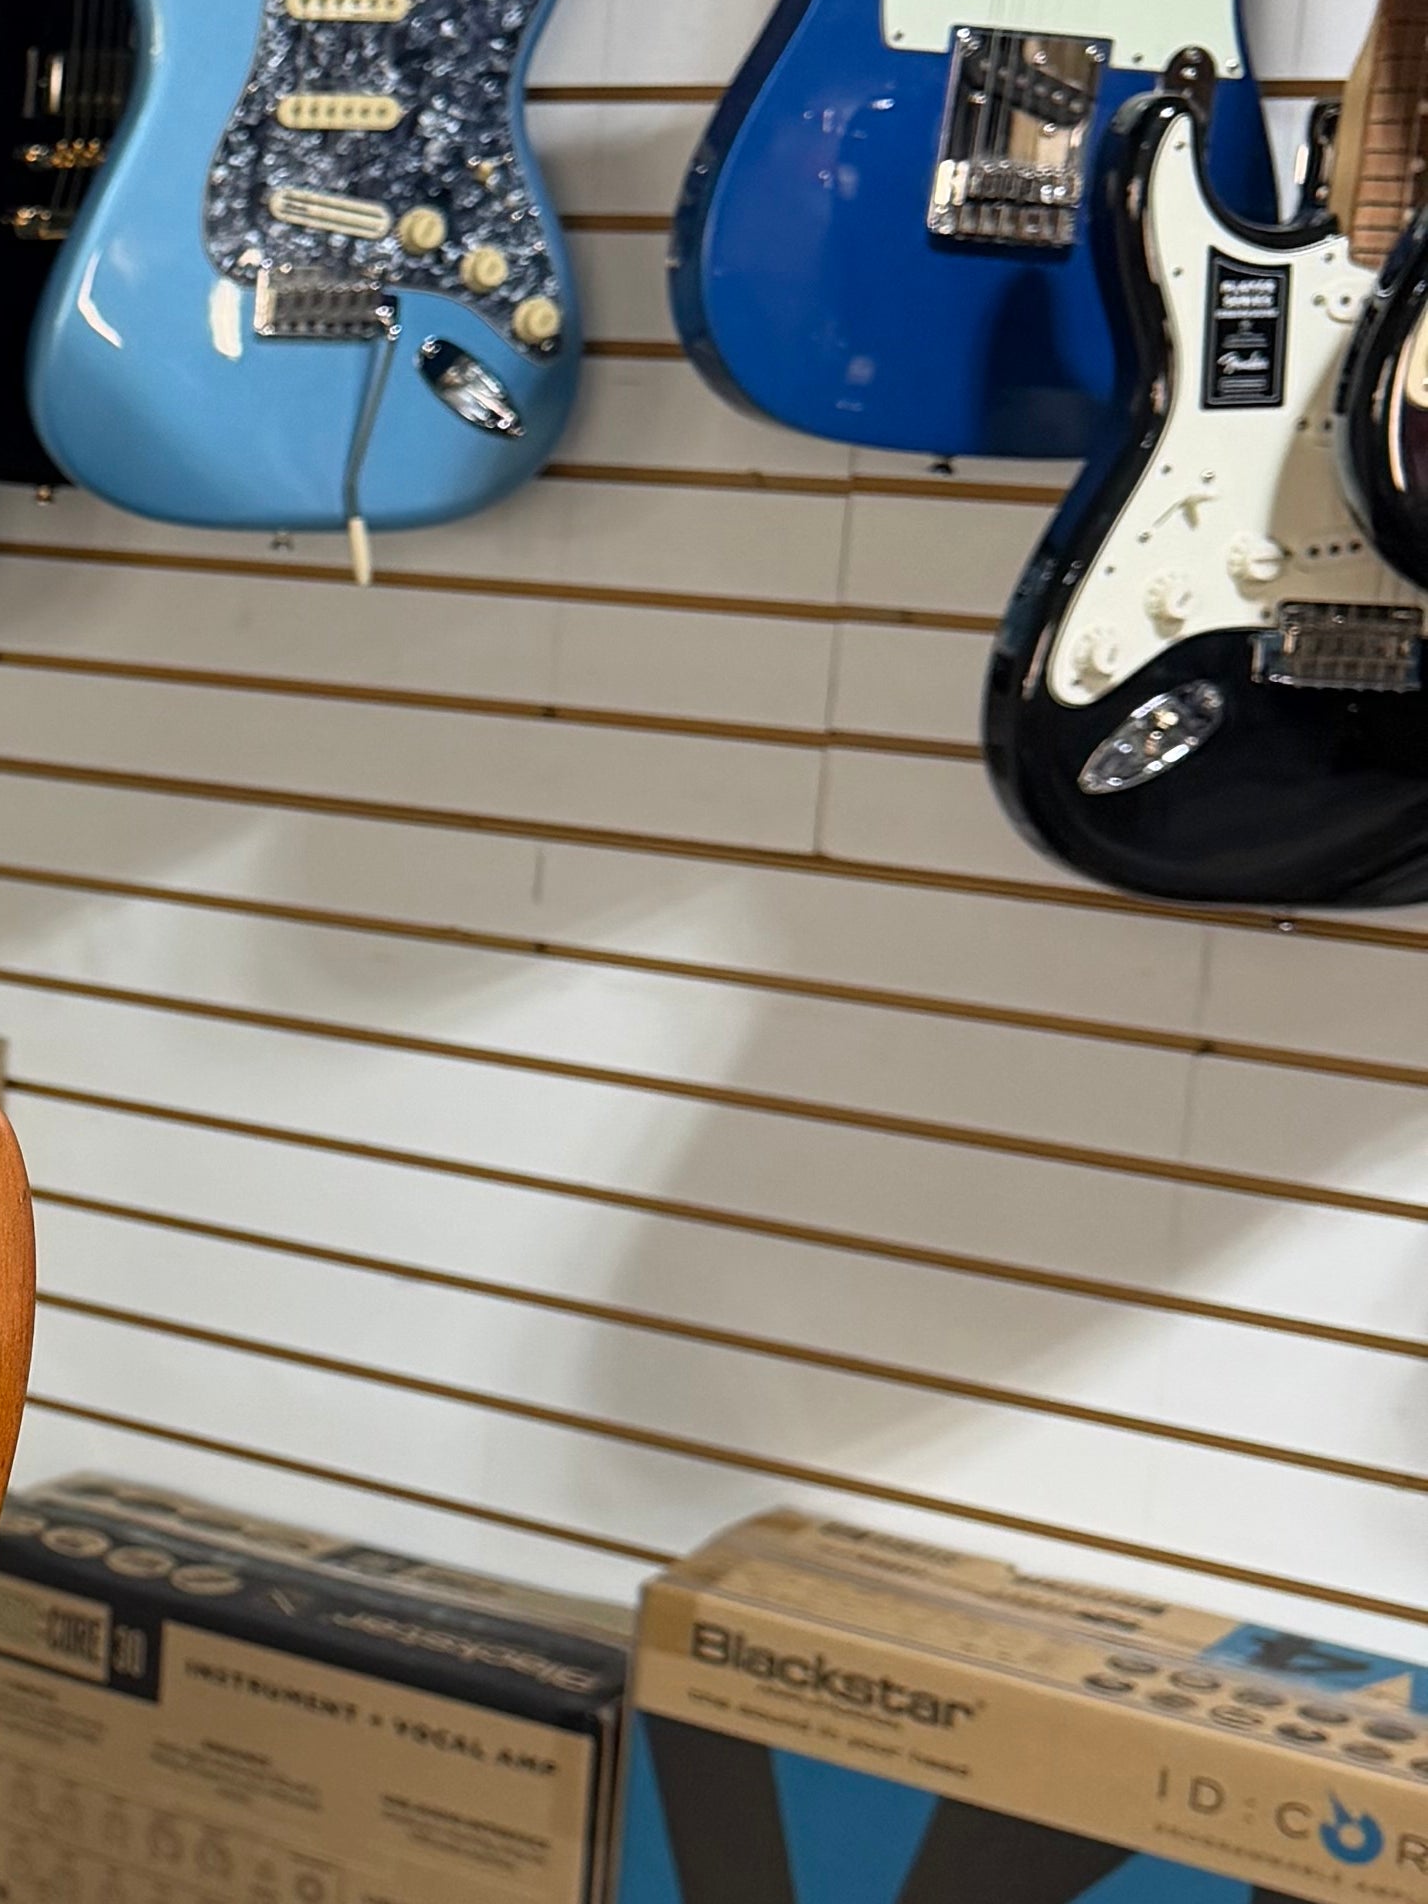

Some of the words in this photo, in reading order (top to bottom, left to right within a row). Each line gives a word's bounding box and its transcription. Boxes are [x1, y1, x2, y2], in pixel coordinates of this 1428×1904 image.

[183, 1656, 358, 1724] INSTRUMENT
[391, 1715, 486, 1763] VOCAL
[495, 1746, 558, 1777] AMP
[690, 1619, 977, 1730] Blackstar
